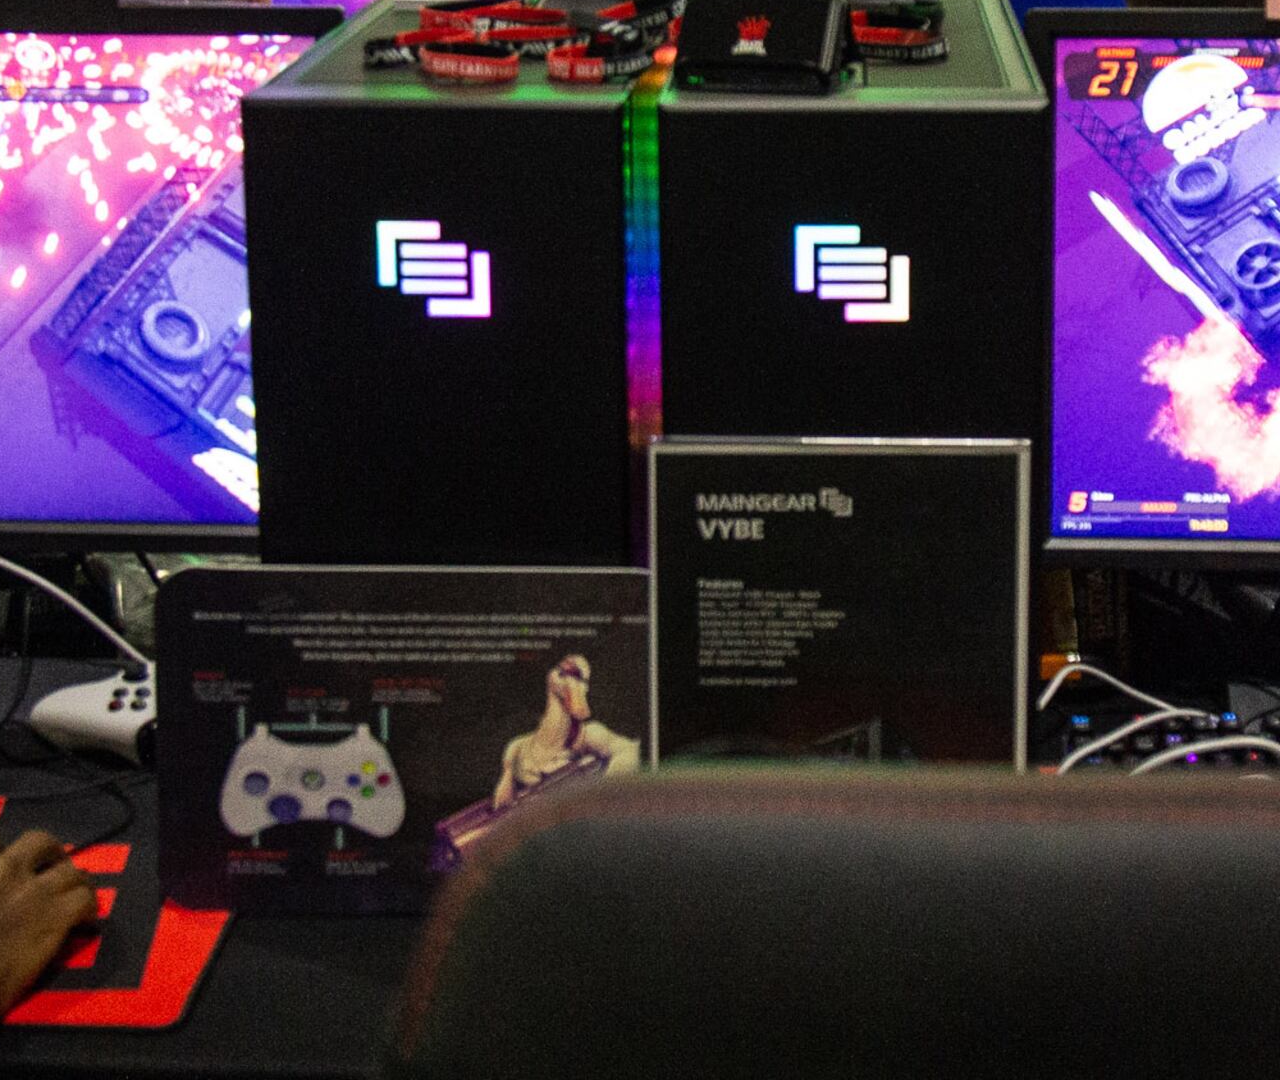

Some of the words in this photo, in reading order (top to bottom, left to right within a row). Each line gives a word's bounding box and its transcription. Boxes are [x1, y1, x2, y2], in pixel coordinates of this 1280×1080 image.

[1088, 60, 1138, 97] 21
[696, 493, 817, 513] MAINGEAR
[697, 518, 765, 541] VYBE
